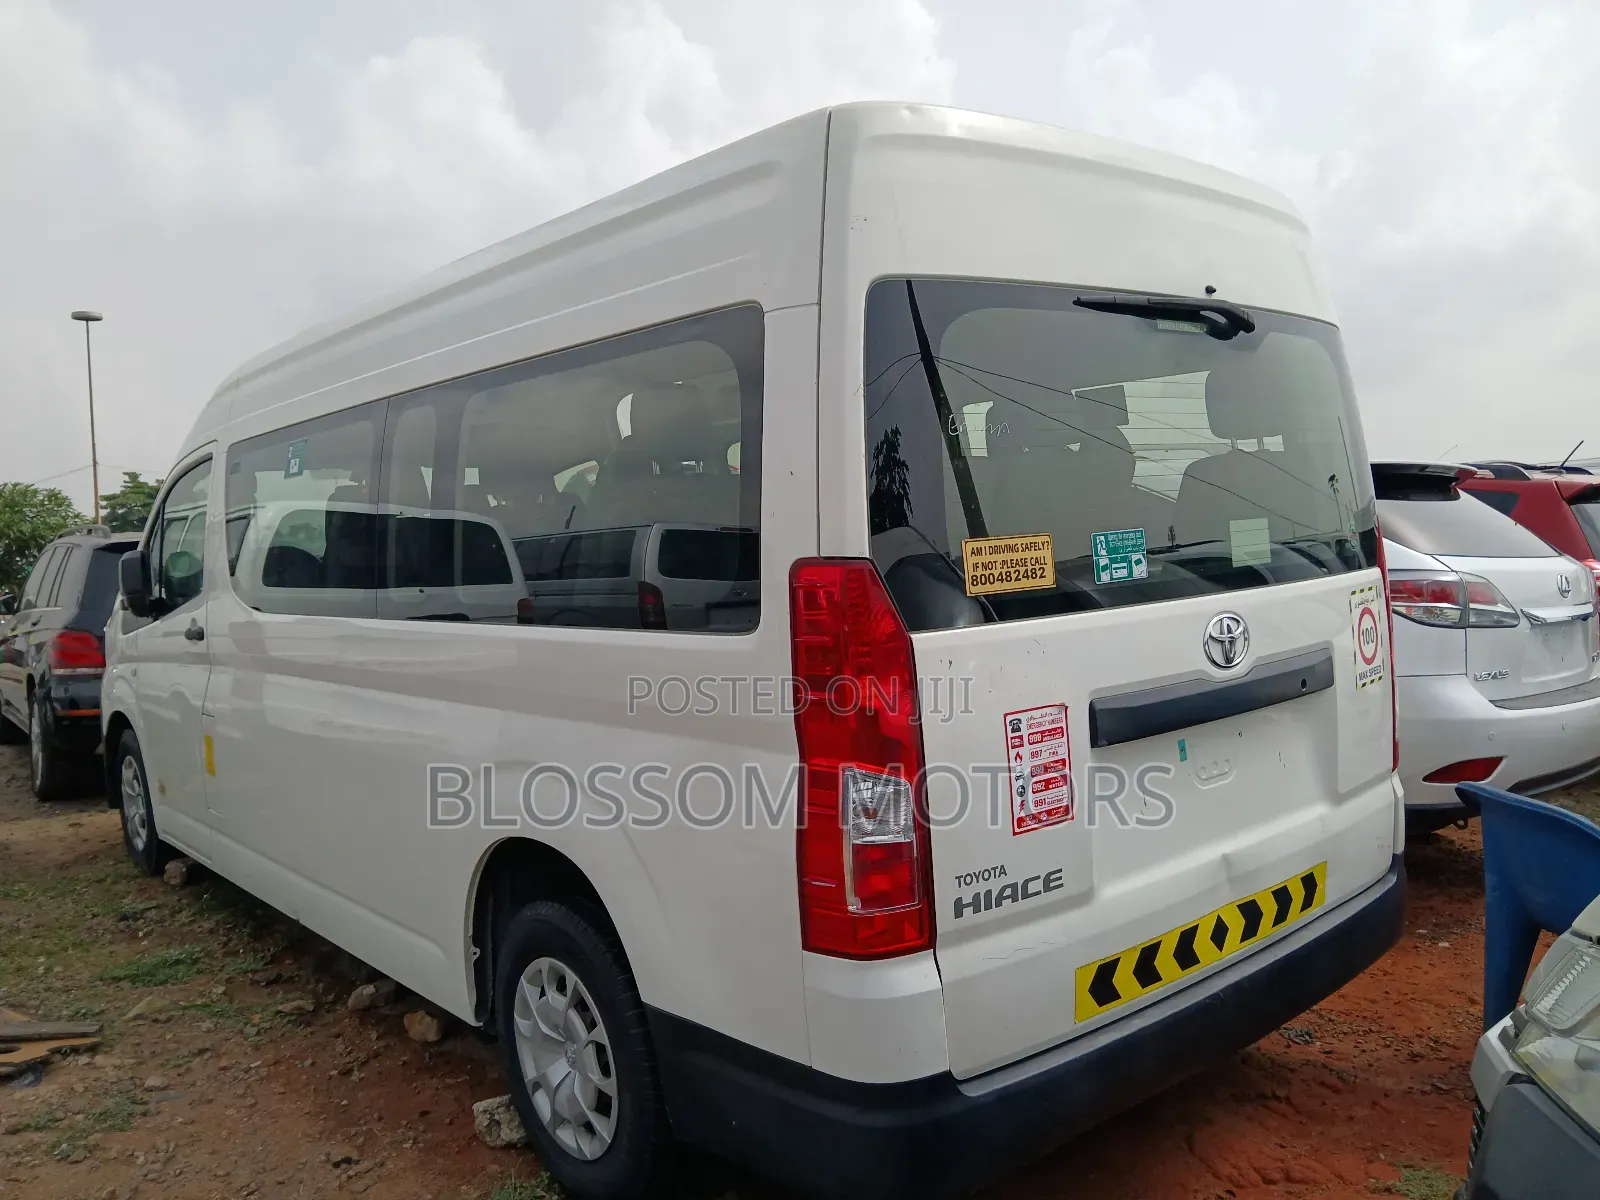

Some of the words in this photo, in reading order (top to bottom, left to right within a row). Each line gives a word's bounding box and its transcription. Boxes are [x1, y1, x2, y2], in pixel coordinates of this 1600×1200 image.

[970, 546, 983, 557] AM
[984, 546, 987, 556] I
[988, 543, 1019, 556] DRIVING
[1020, 540, 1050, 552] SAFELY?
[972, 562, 980, 572] IF
[981, 560, 998, 571] NOT
[1029, 555, 1047, 567] CALL
[970, 567, 1047, 587] 800482482
[1361, 626, 1375, 646] 100
[1358, 670, 1369, 681] MAX
[1368, 665, 1382, 677] SPEED
[1473, 668, 1509, 682] LEXUS
[1030, 749, 1043, 759] 997
[1032, 781, 1046, 792] 992
[1033, 797, 1047, 808] 991
[954, 864, 1008, 888] TOYOTA
[953, 868, 1064, 919] HIACE
